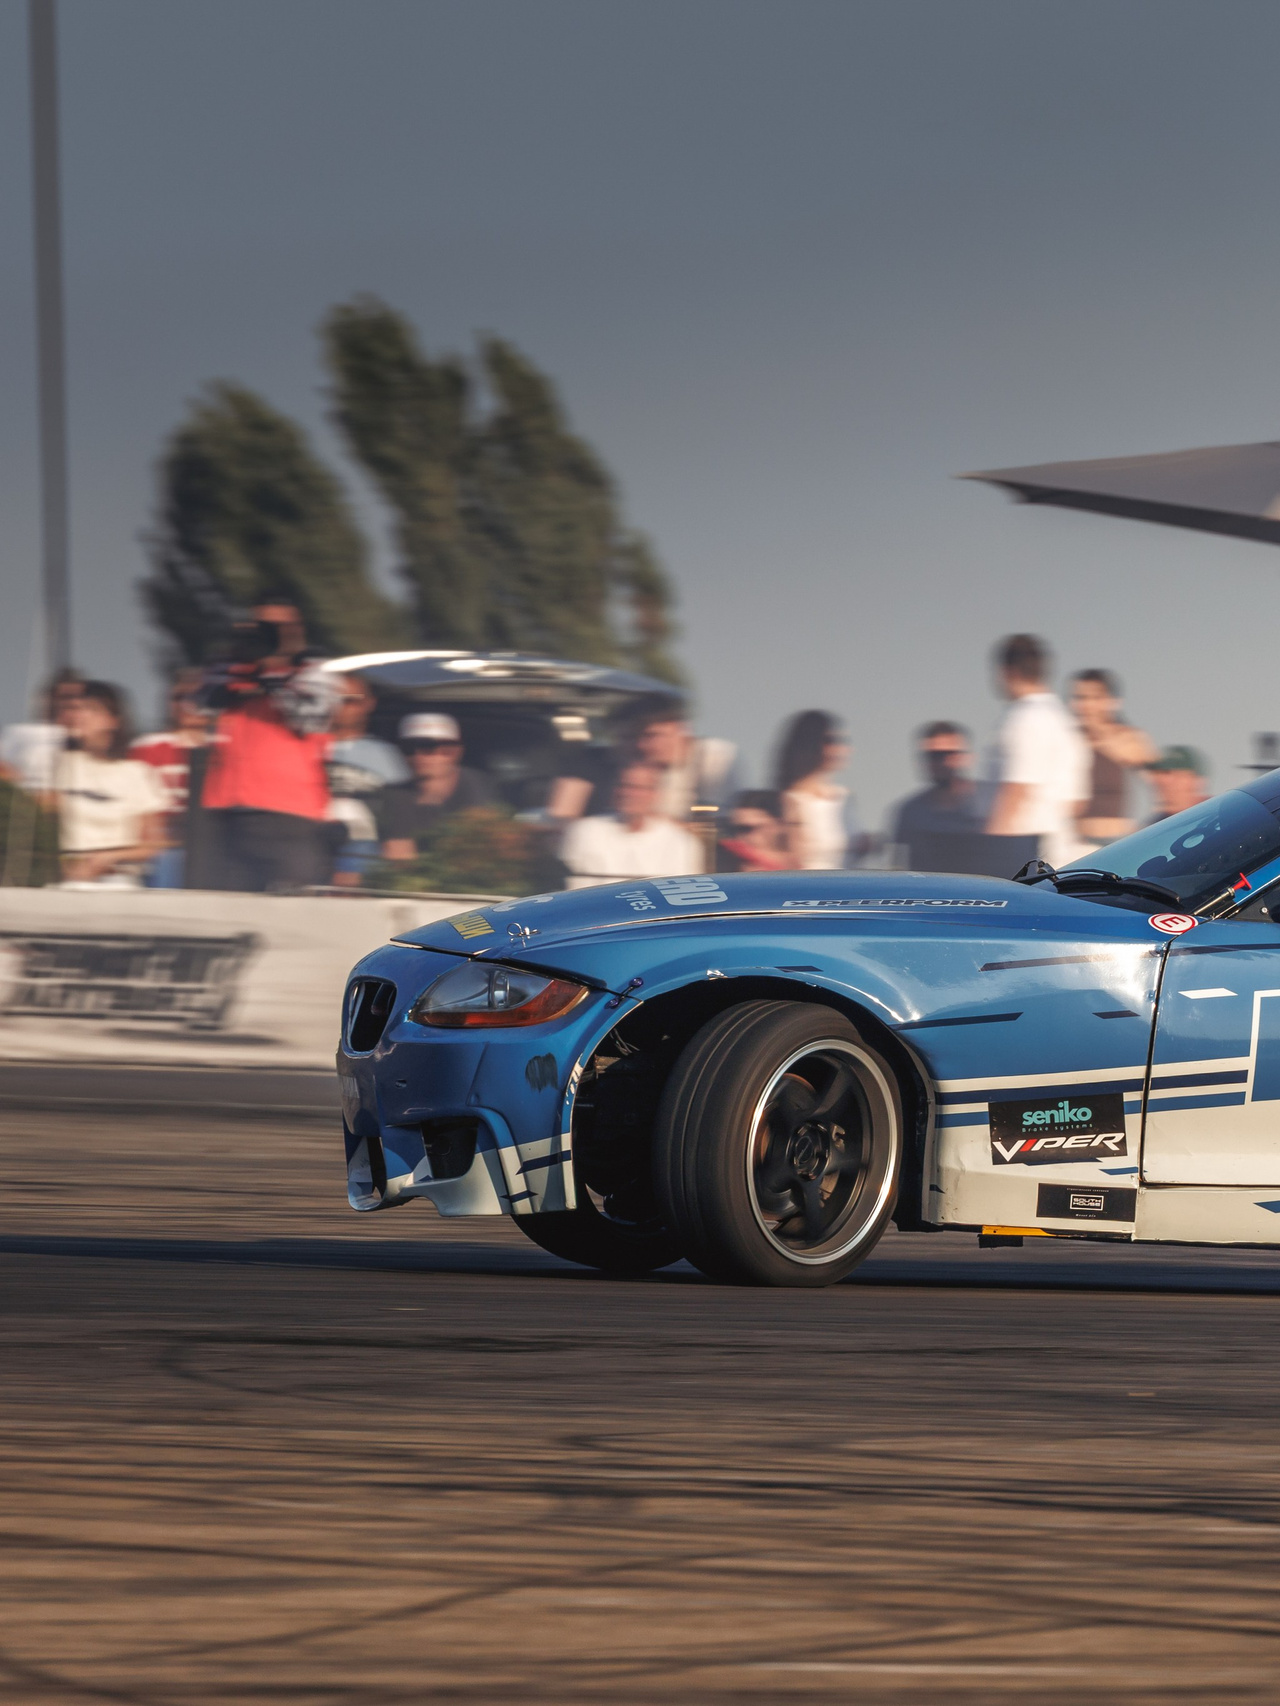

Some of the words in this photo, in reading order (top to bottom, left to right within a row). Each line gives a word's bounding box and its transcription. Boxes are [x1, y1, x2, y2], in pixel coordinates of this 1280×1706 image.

[615, 890, 656, 911] tyres
[1022, 1100, 1092, 1126] seniko
[992, 1132, 1125, 1162] VIPER
